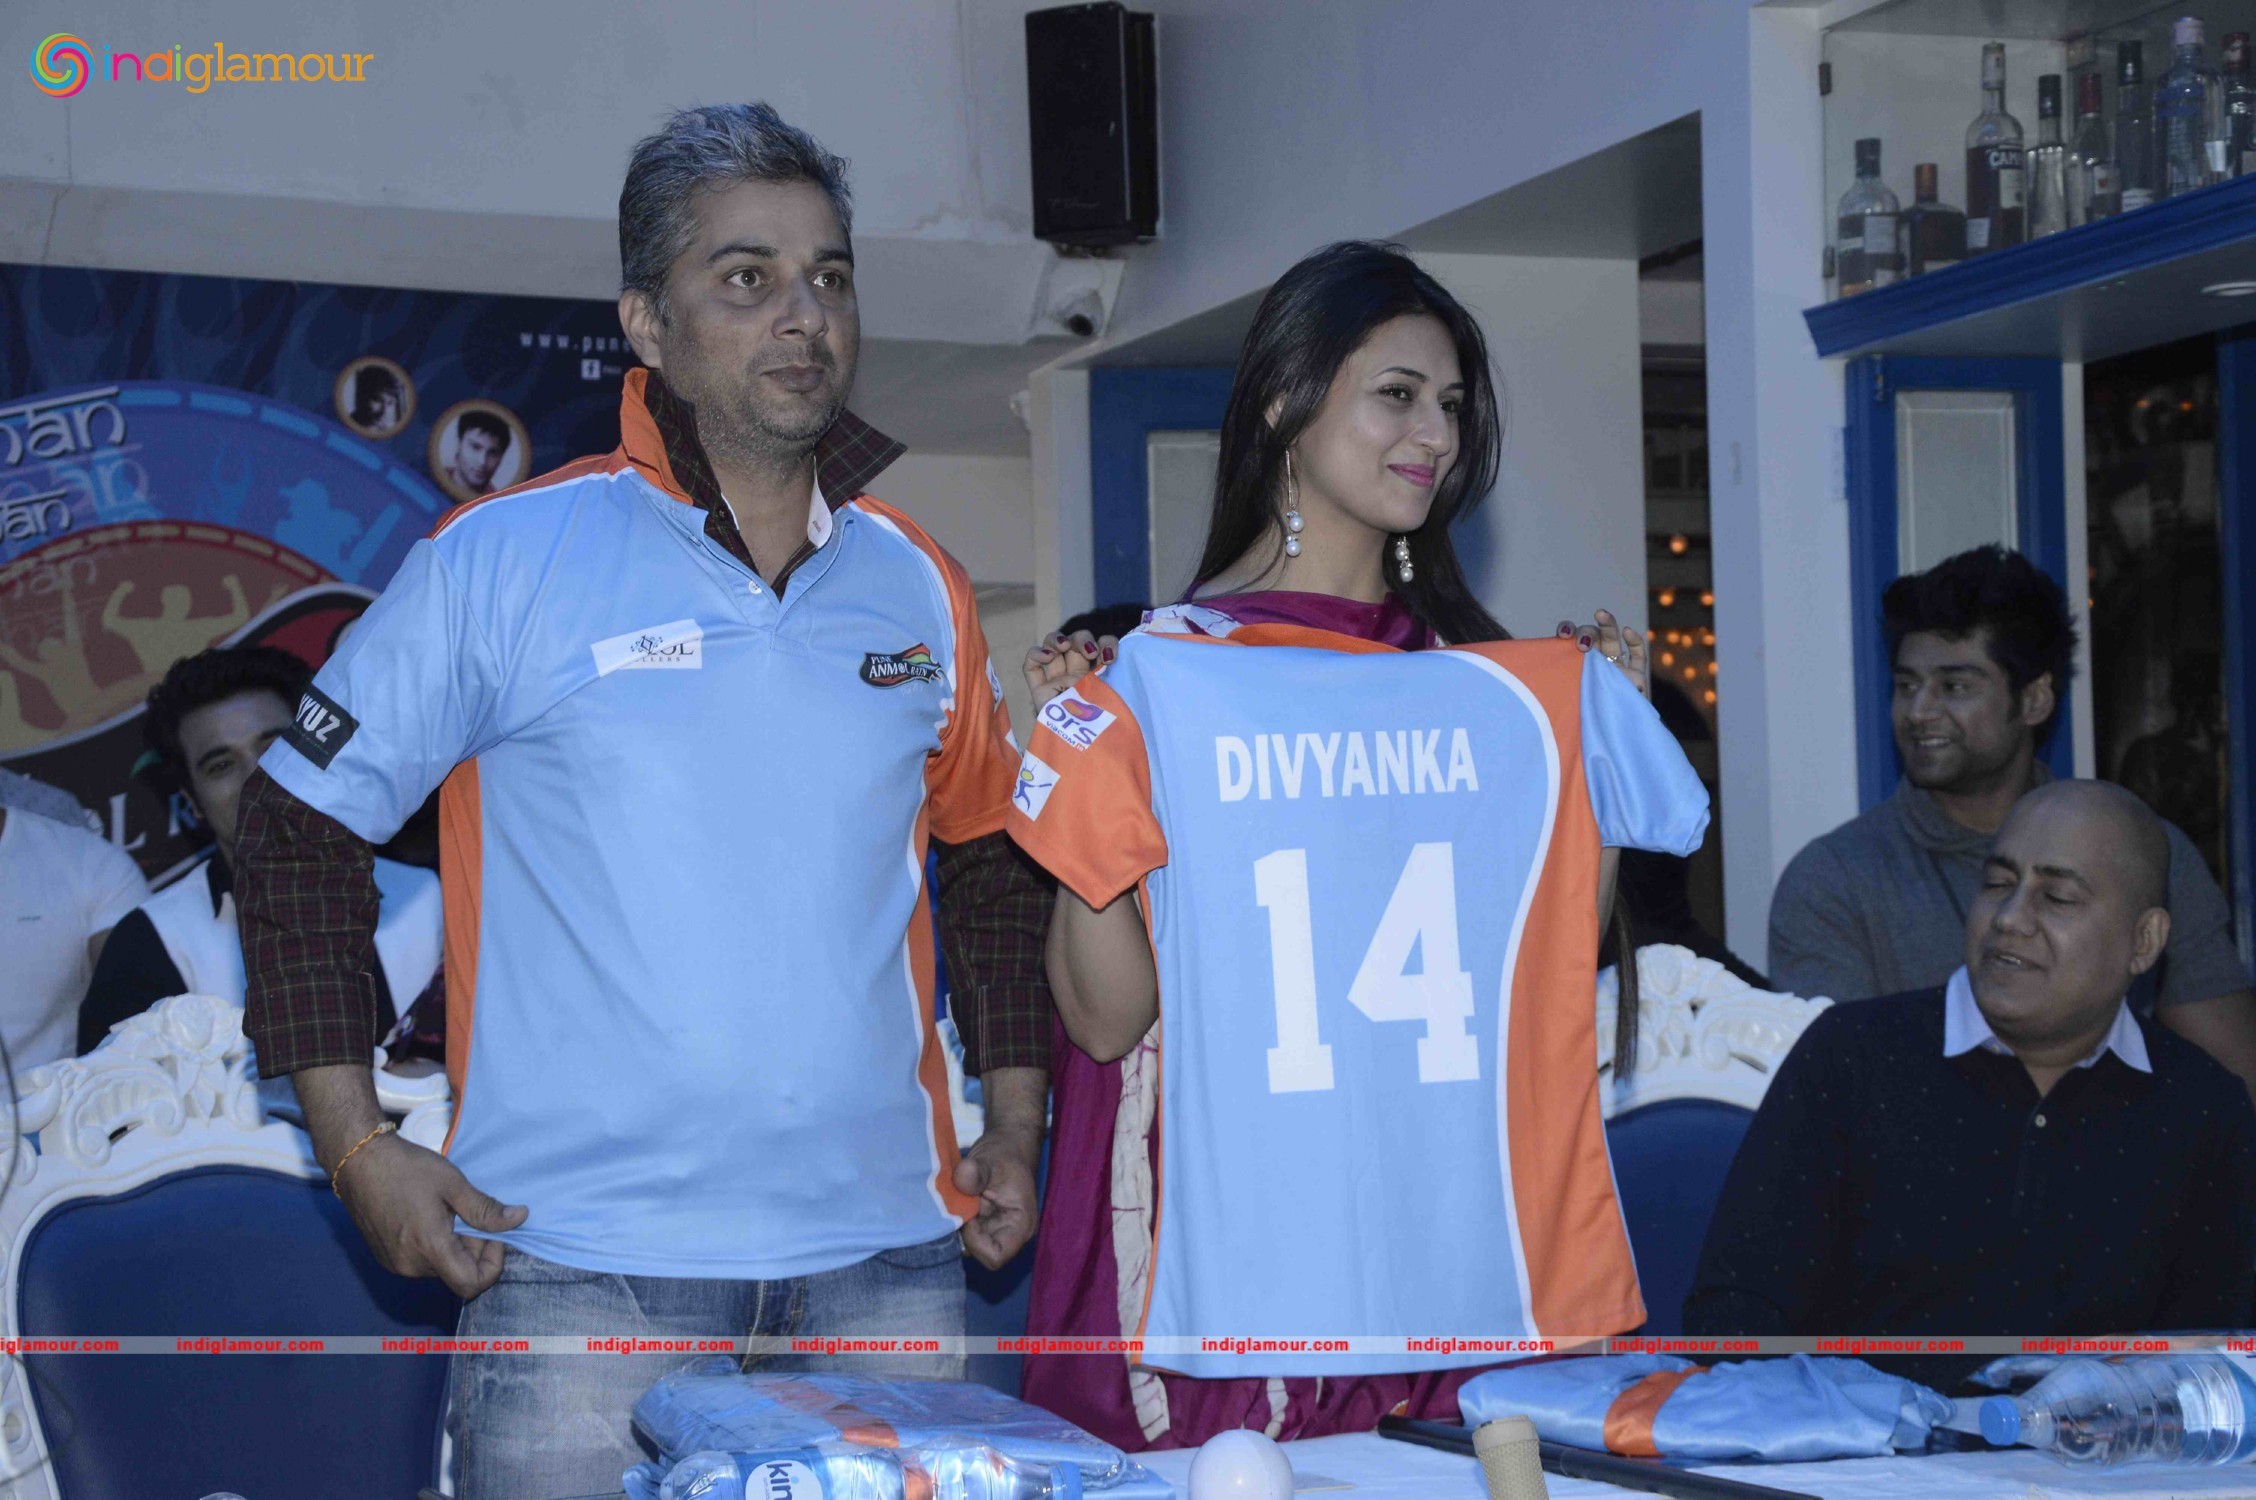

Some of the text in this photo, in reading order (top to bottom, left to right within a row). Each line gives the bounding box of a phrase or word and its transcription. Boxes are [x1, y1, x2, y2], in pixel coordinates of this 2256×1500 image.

[1045, 703, 1098, 745] ors
[1215, 728, 1479, 802] DIVYANKA
[1254, 842, 1480, 1094] 14
